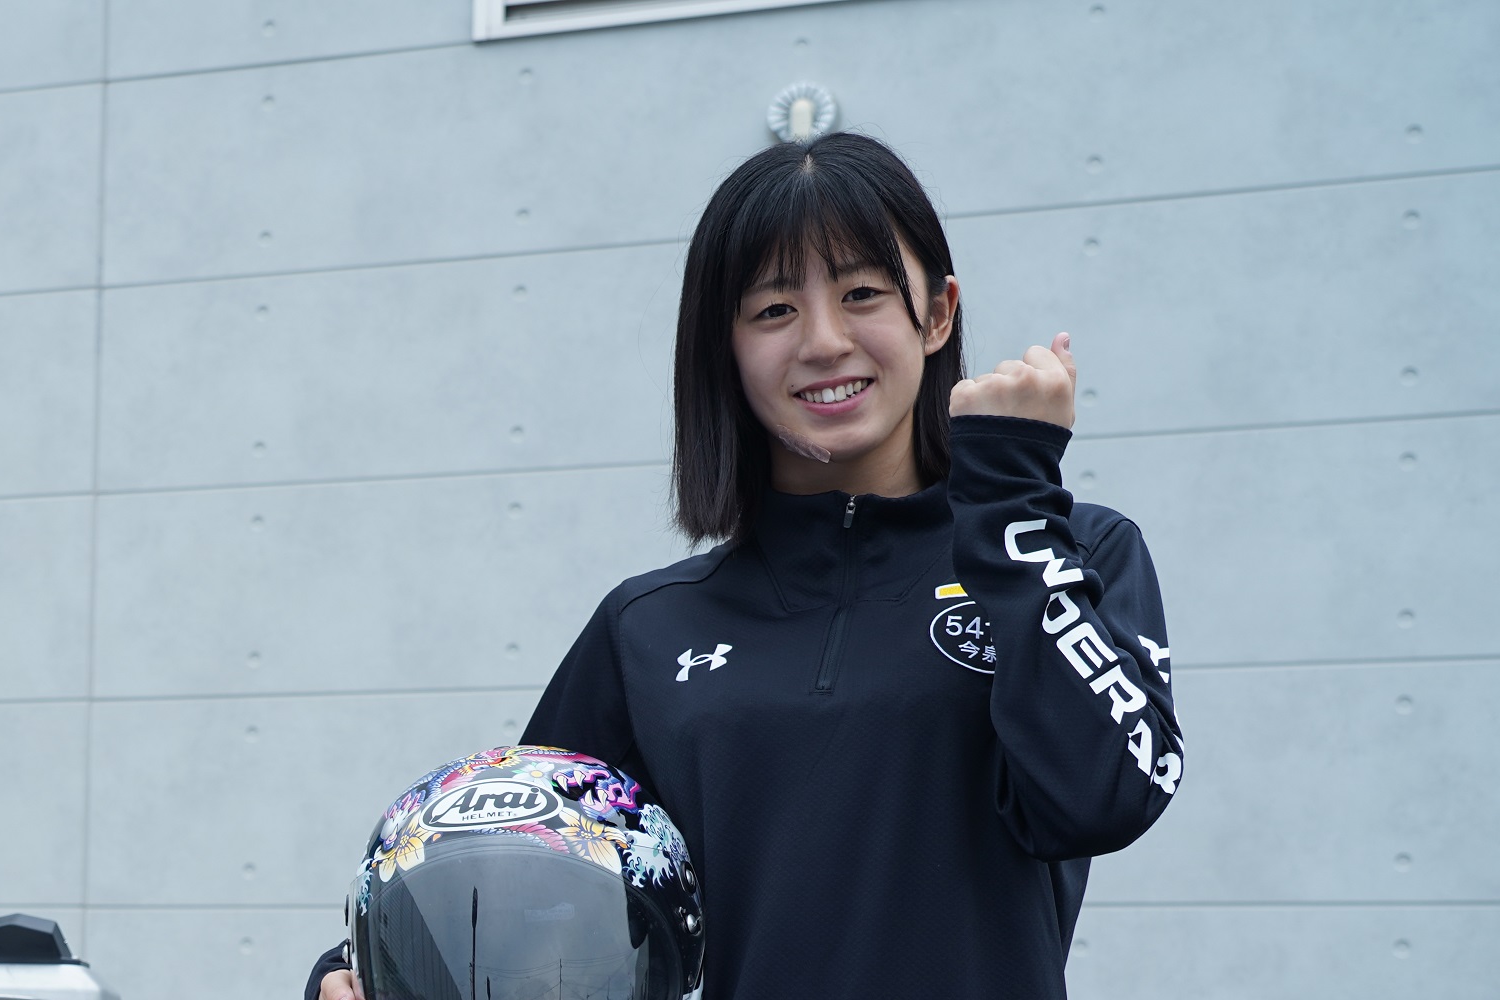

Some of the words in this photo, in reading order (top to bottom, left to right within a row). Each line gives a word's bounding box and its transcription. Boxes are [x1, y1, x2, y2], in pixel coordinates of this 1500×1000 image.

[1004, 518, 1148, 725] UNDER
[429, 787, 542, 823] Arai
[462, 811, 512, 821] HELMET
